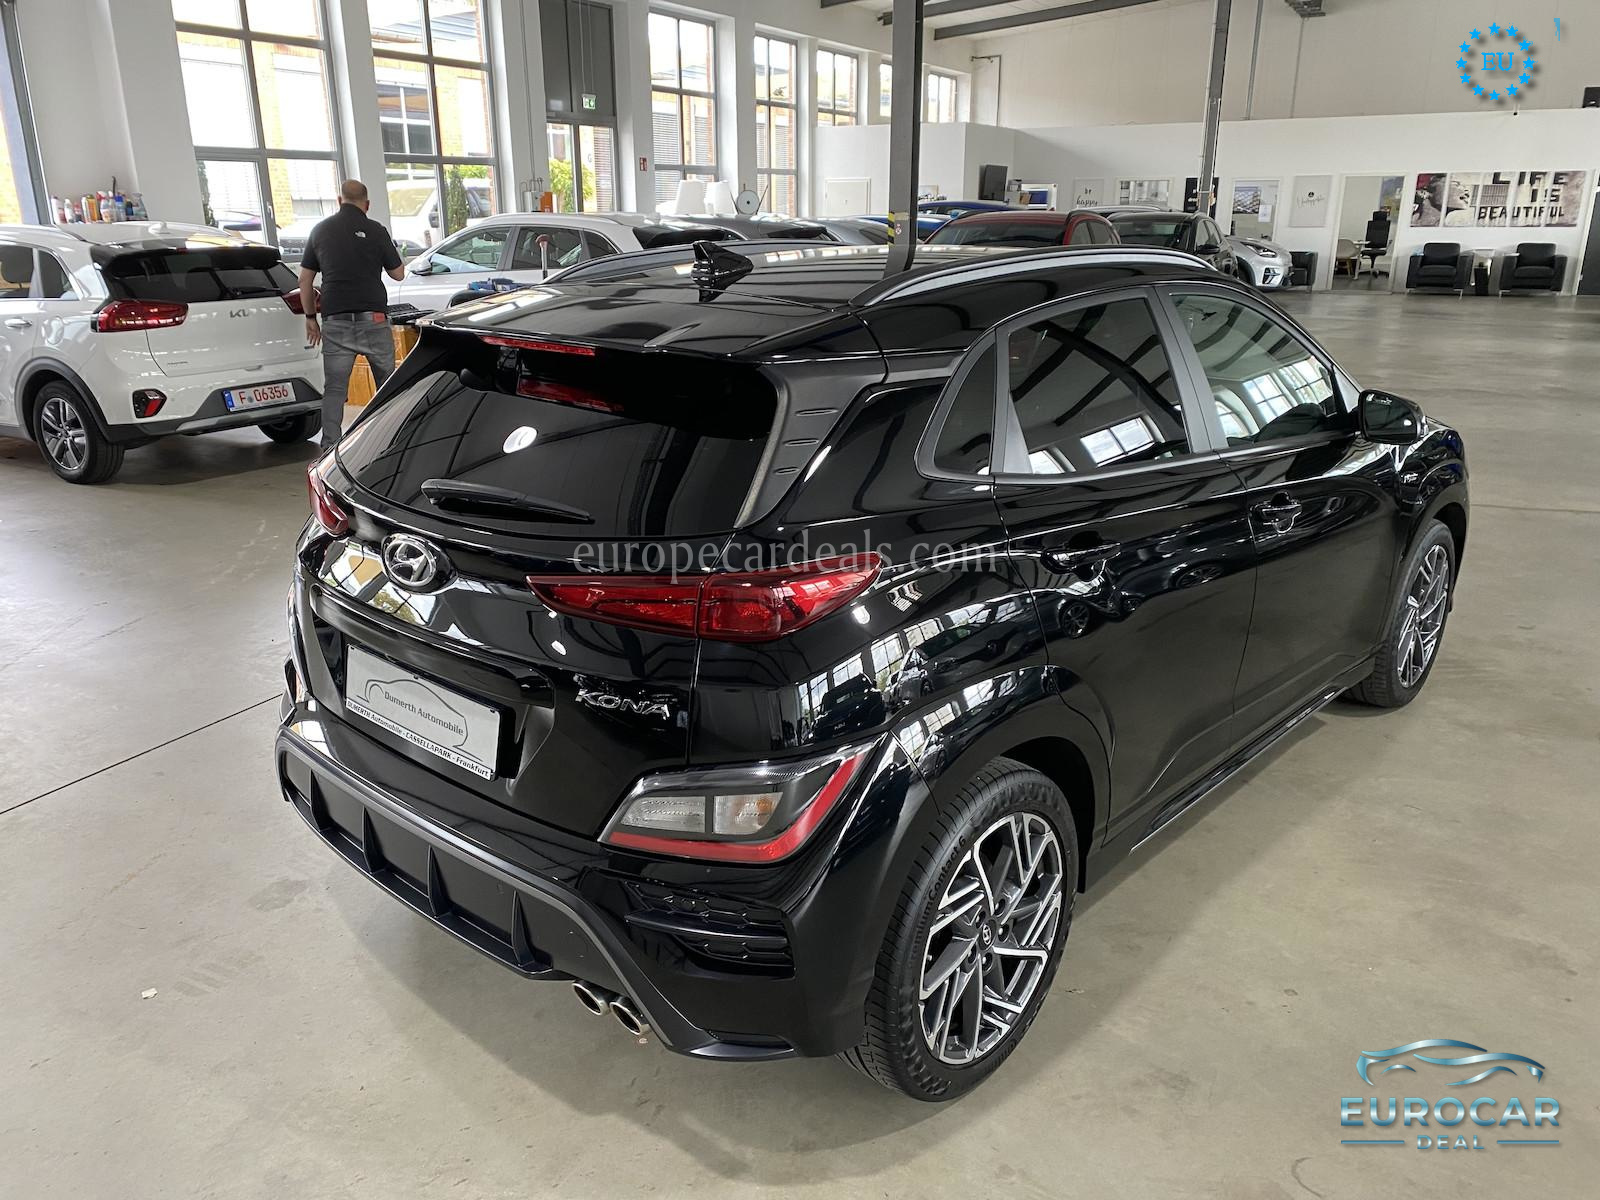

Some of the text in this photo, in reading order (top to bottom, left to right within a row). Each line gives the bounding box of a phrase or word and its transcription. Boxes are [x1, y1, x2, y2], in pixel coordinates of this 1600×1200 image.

[1492, 172, 1569, 185] LIFE
[1530, 188, 1561, 203] IS
[1477, 205, 1565, 221] BEAUTIFUL
[239, 385, 289, 404] F 06356
[575, 687, 671, 720] KONA
[417, 708, 464, 736] Automobile
[405, 731, 452, 759] CASSELLAPARK
[456, 757, 489, 777] Frankfurt
[908, 835, 966, 969] remiumContact 6
